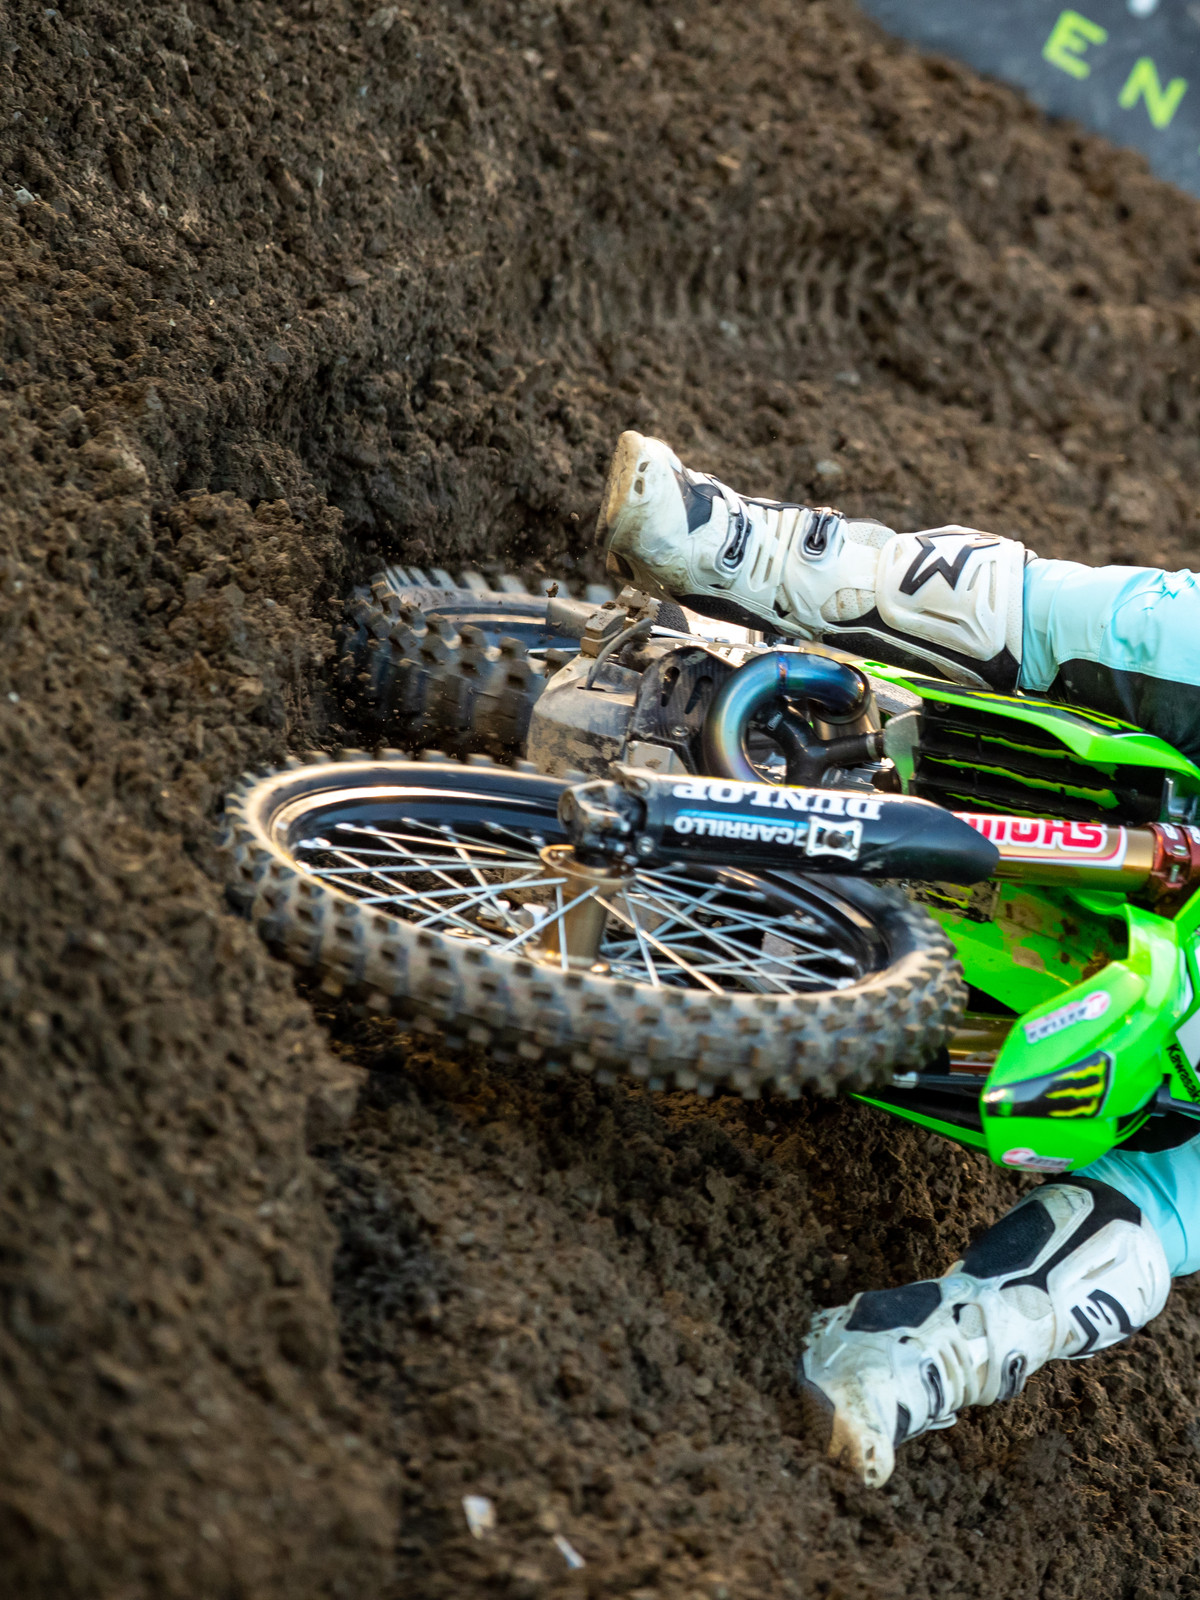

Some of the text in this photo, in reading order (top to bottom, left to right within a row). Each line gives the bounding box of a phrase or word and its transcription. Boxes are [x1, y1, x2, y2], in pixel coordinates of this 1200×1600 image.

[672, 781, 882, 821] DUNLOP
[674, 815, 795, 846] CARRILLO
[966, 818, 1107, 853] SHOW
